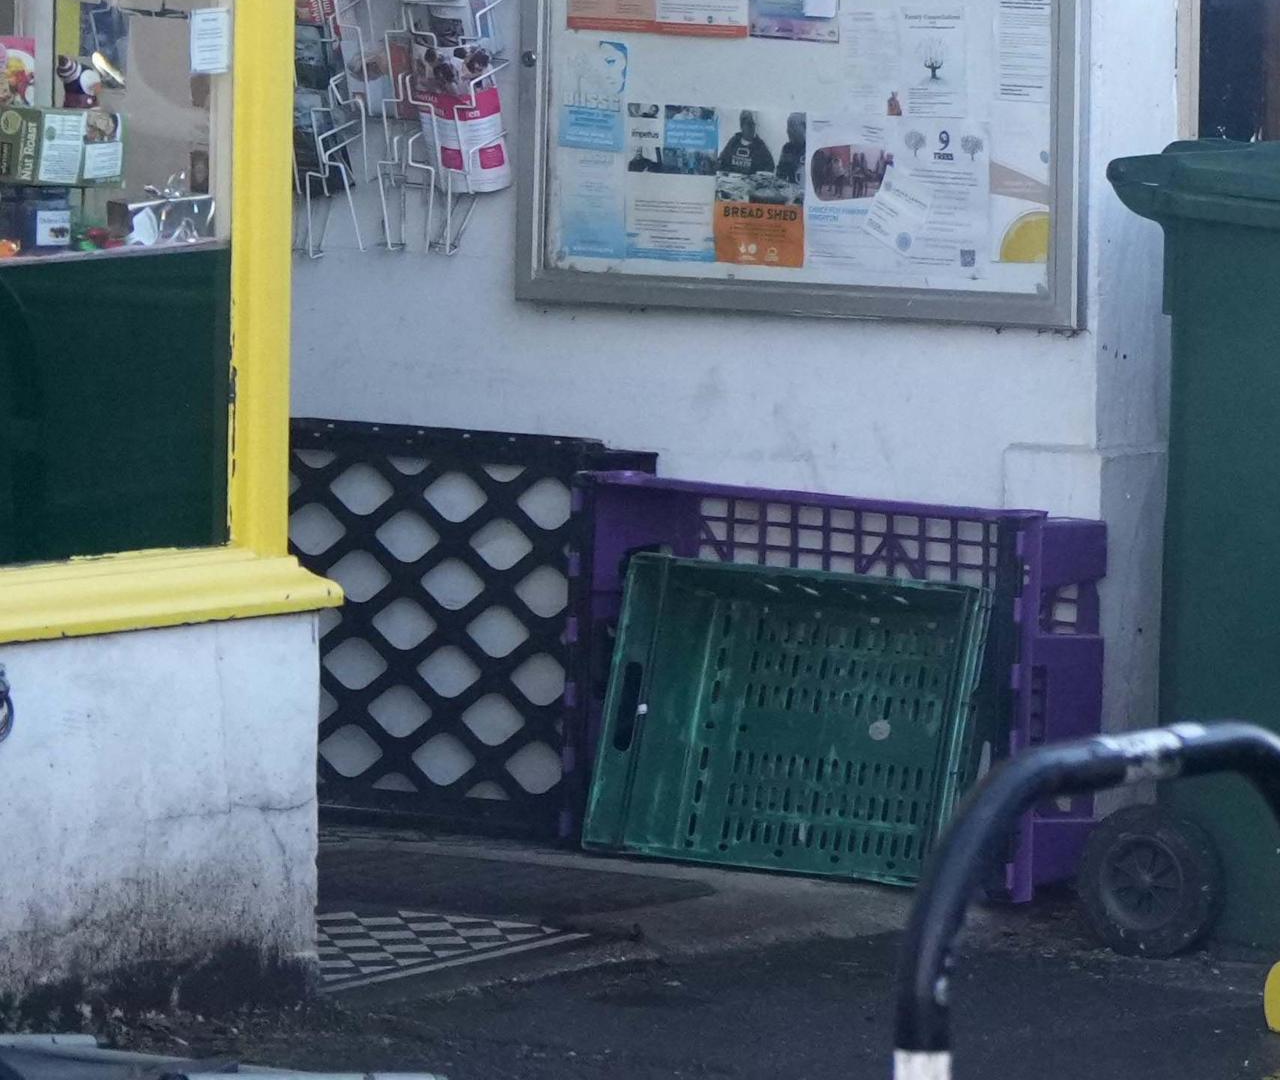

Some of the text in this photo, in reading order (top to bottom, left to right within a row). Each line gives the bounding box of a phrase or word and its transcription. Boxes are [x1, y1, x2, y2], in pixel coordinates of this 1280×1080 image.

[631, 128, 660, 141] impetus
[938, 130, 950, 151] 9
[723, 206, 798, 221] BREAD SHED
